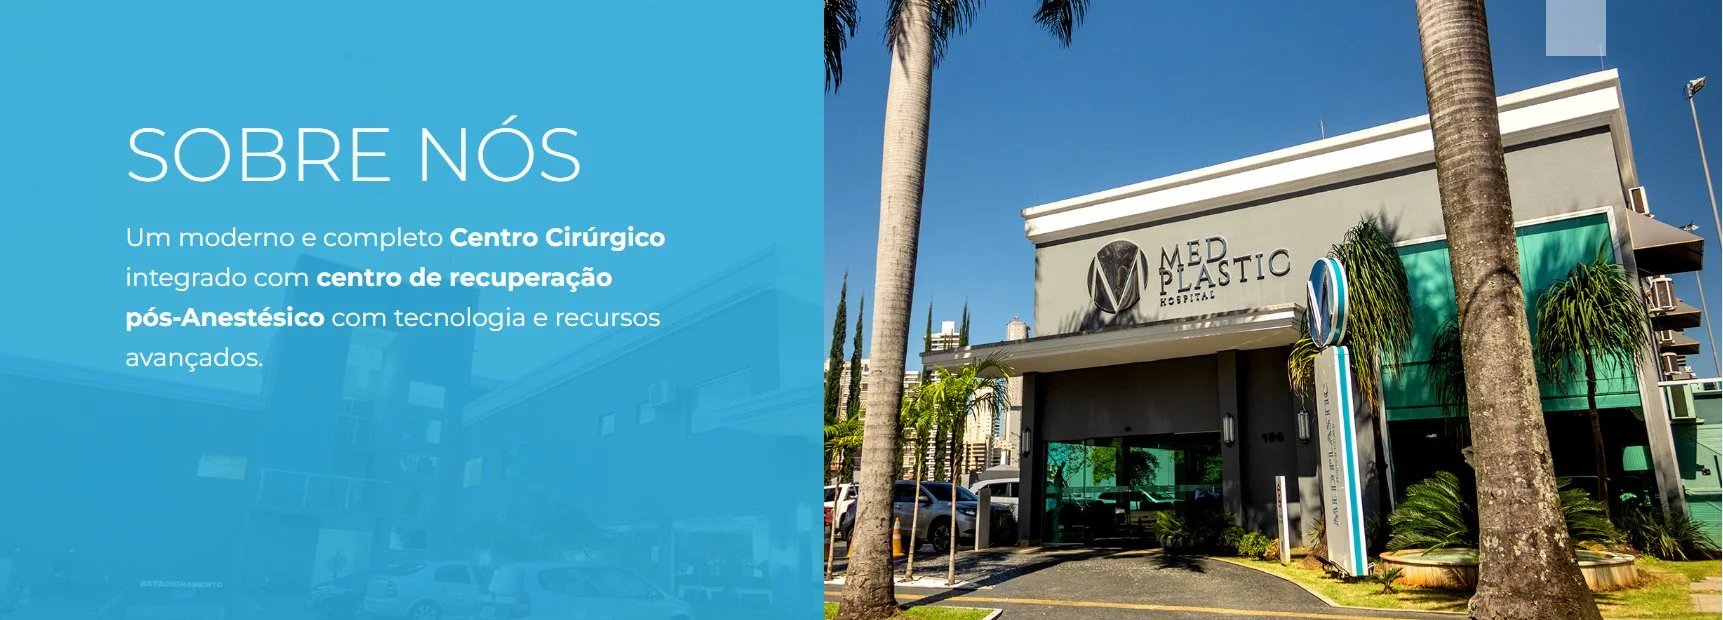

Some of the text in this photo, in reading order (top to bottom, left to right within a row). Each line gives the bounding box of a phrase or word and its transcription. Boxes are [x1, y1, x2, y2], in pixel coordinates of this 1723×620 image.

[1159, 236, 1228, 272] MED
[1158, 249, 1291, 296] PLASTIC
[1160, 290, 1216, 307] HOSPITAL
